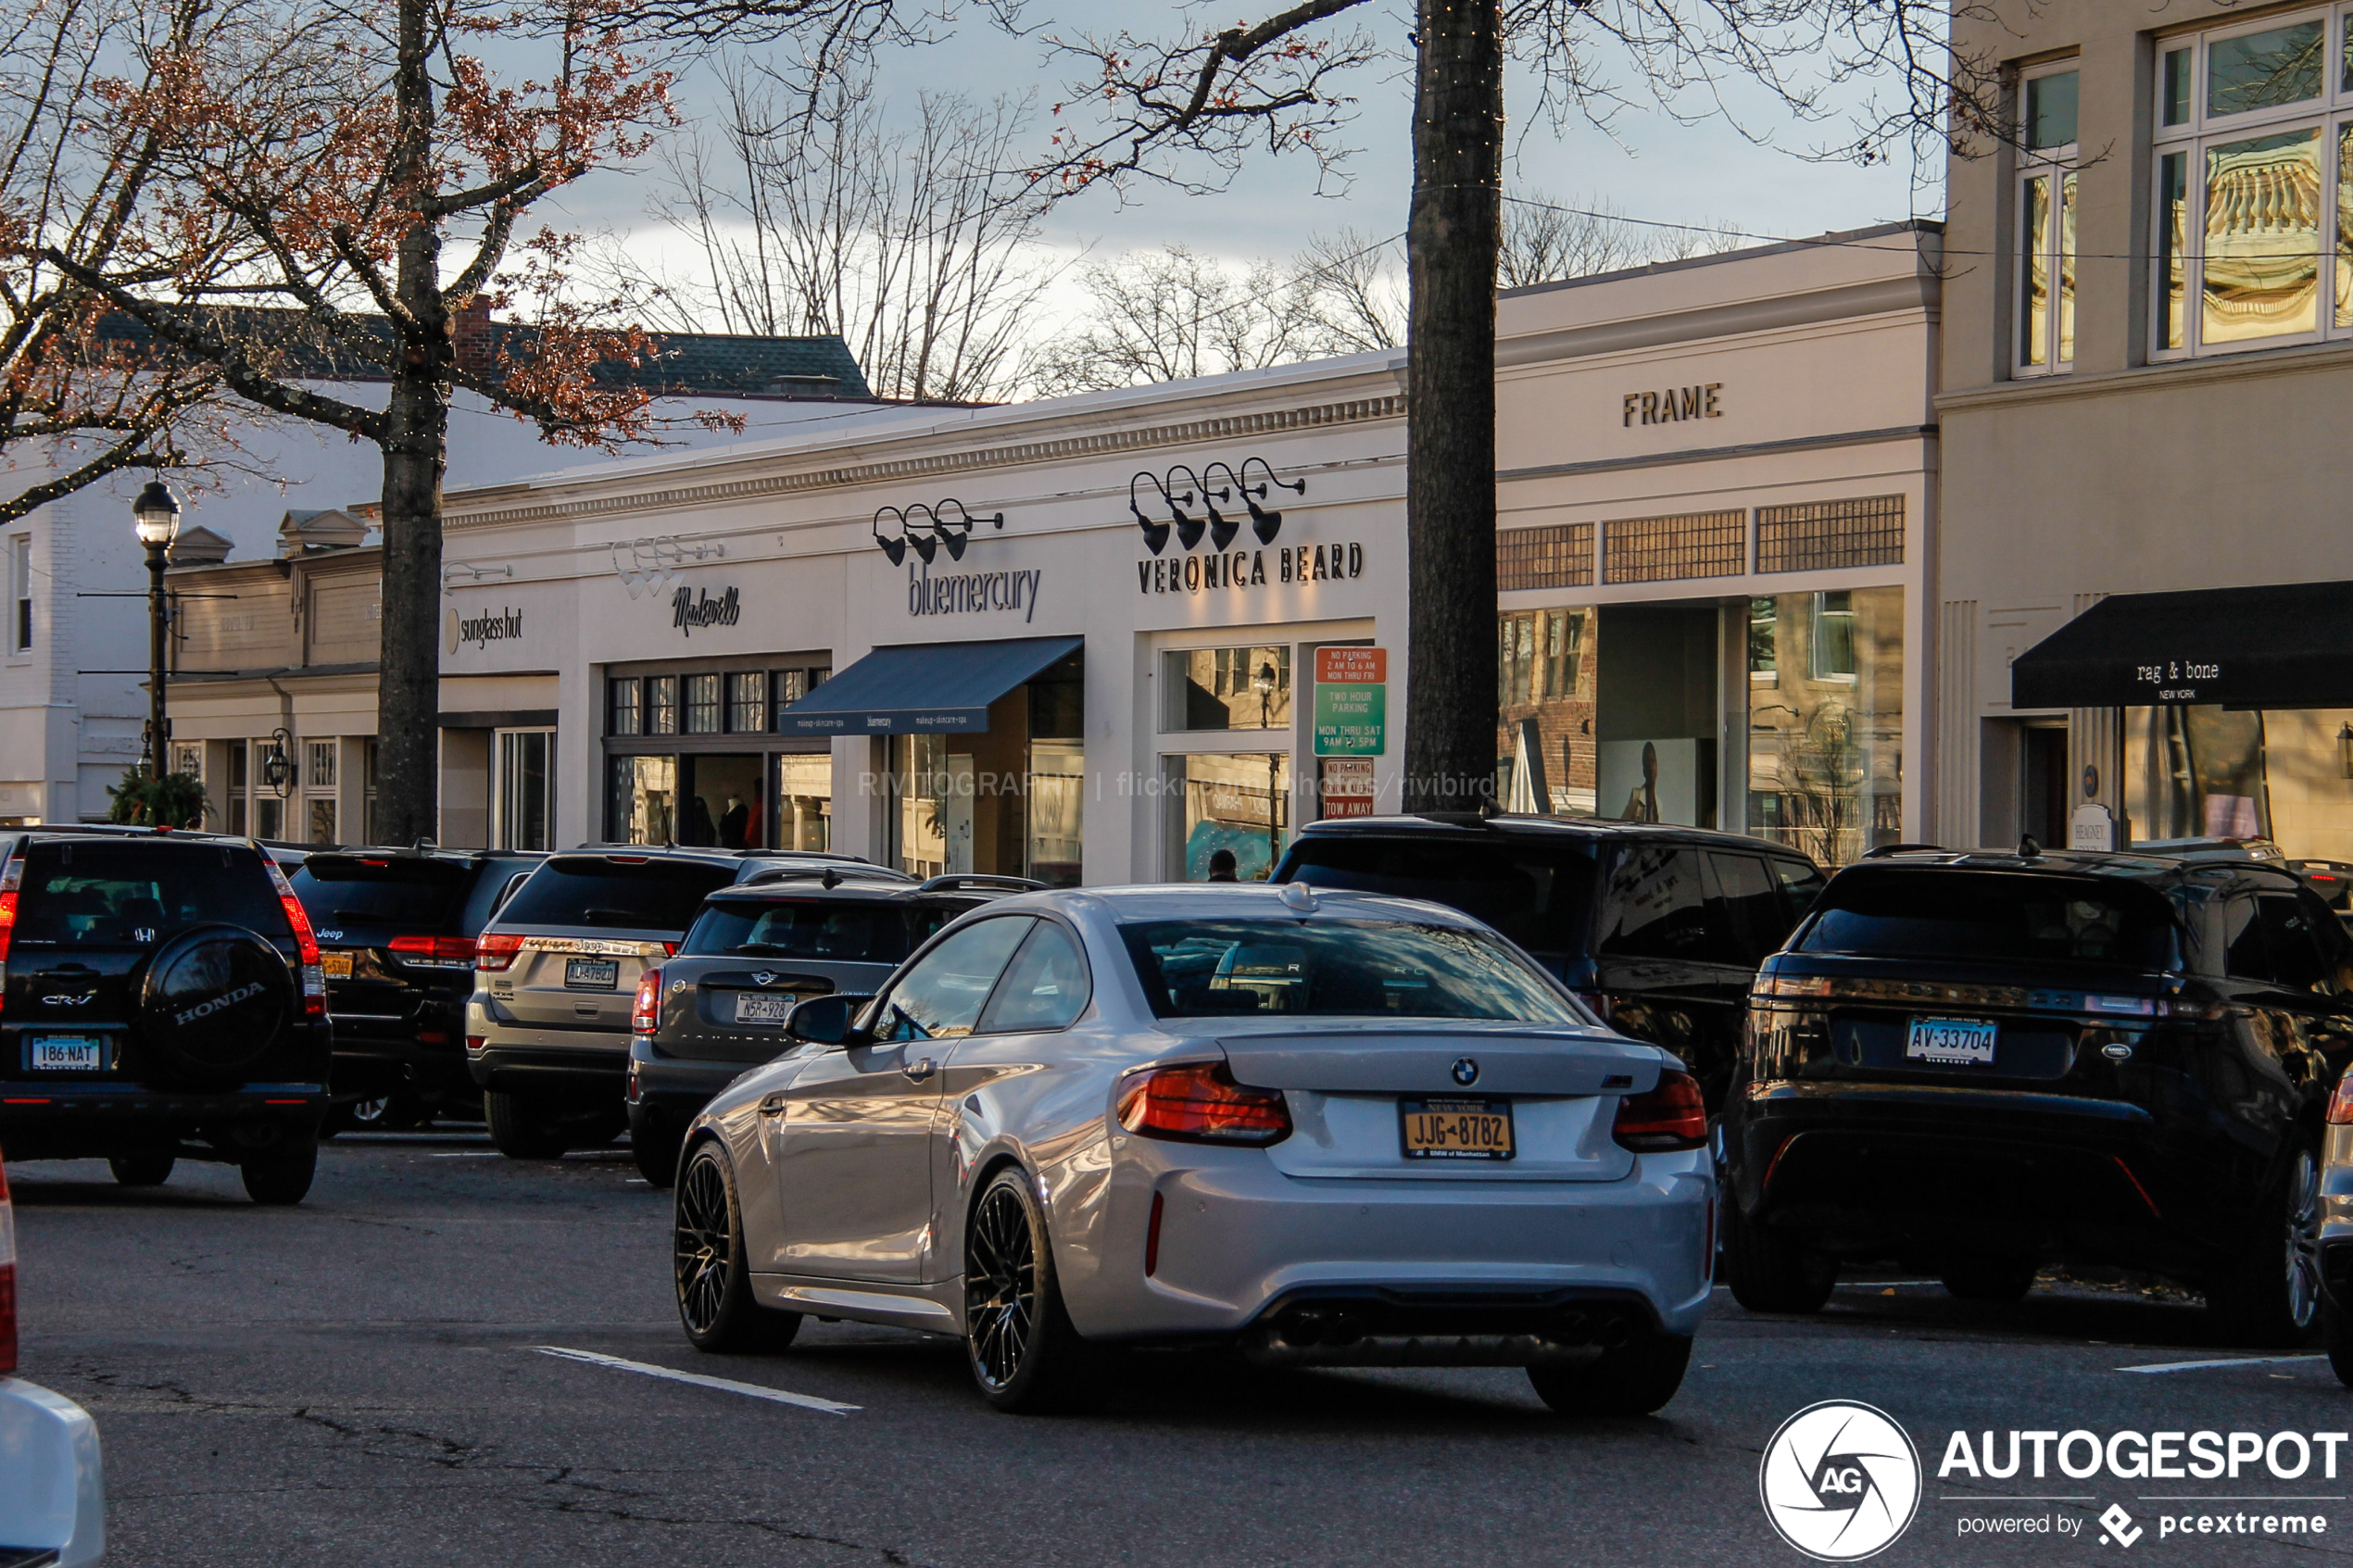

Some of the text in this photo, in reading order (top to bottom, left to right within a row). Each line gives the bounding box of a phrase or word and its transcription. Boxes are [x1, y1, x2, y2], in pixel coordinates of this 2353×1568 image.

[1623, 382, 1724, 427] FRAME
[1138, 542, 1363, 594] VERONICA BEARD
[909, 561, 1041, 623] bluemercury
[672, 585, 739, 637] Madewell
[461, 607, 522, 650] sunglass hut
[1331, 651, 1372, 659] NO PARKING
[1327, 671, 1375, 680] MON THRU FRI
[2137, 660, 2219, 684] rag & bone
[1329, 692, 1372, 701] TWO HOUR
[2159, 689, 2196, 699] NEW YORK
[1332, 703, 1368, 713] PARKING
[867, 715, 891, 729] bluemercury
[1318, 726, 1380, 735] MON THRU SAT
[1324, 737, 1377, 746] 9AM TO 5PM
[1328, 763, 1370, 772] NO PARKING
[1327, 784, 1371, 794] SNOW ALERT
[1327, 803, 1371, 815] TOW AWAY
[316, 928, 343, 940] Jeep
[574, 939, 603, 953] Jeep
[174, 981, 267, 1025] HONDA
[1428, 1104, 1453, 1112] NEW
